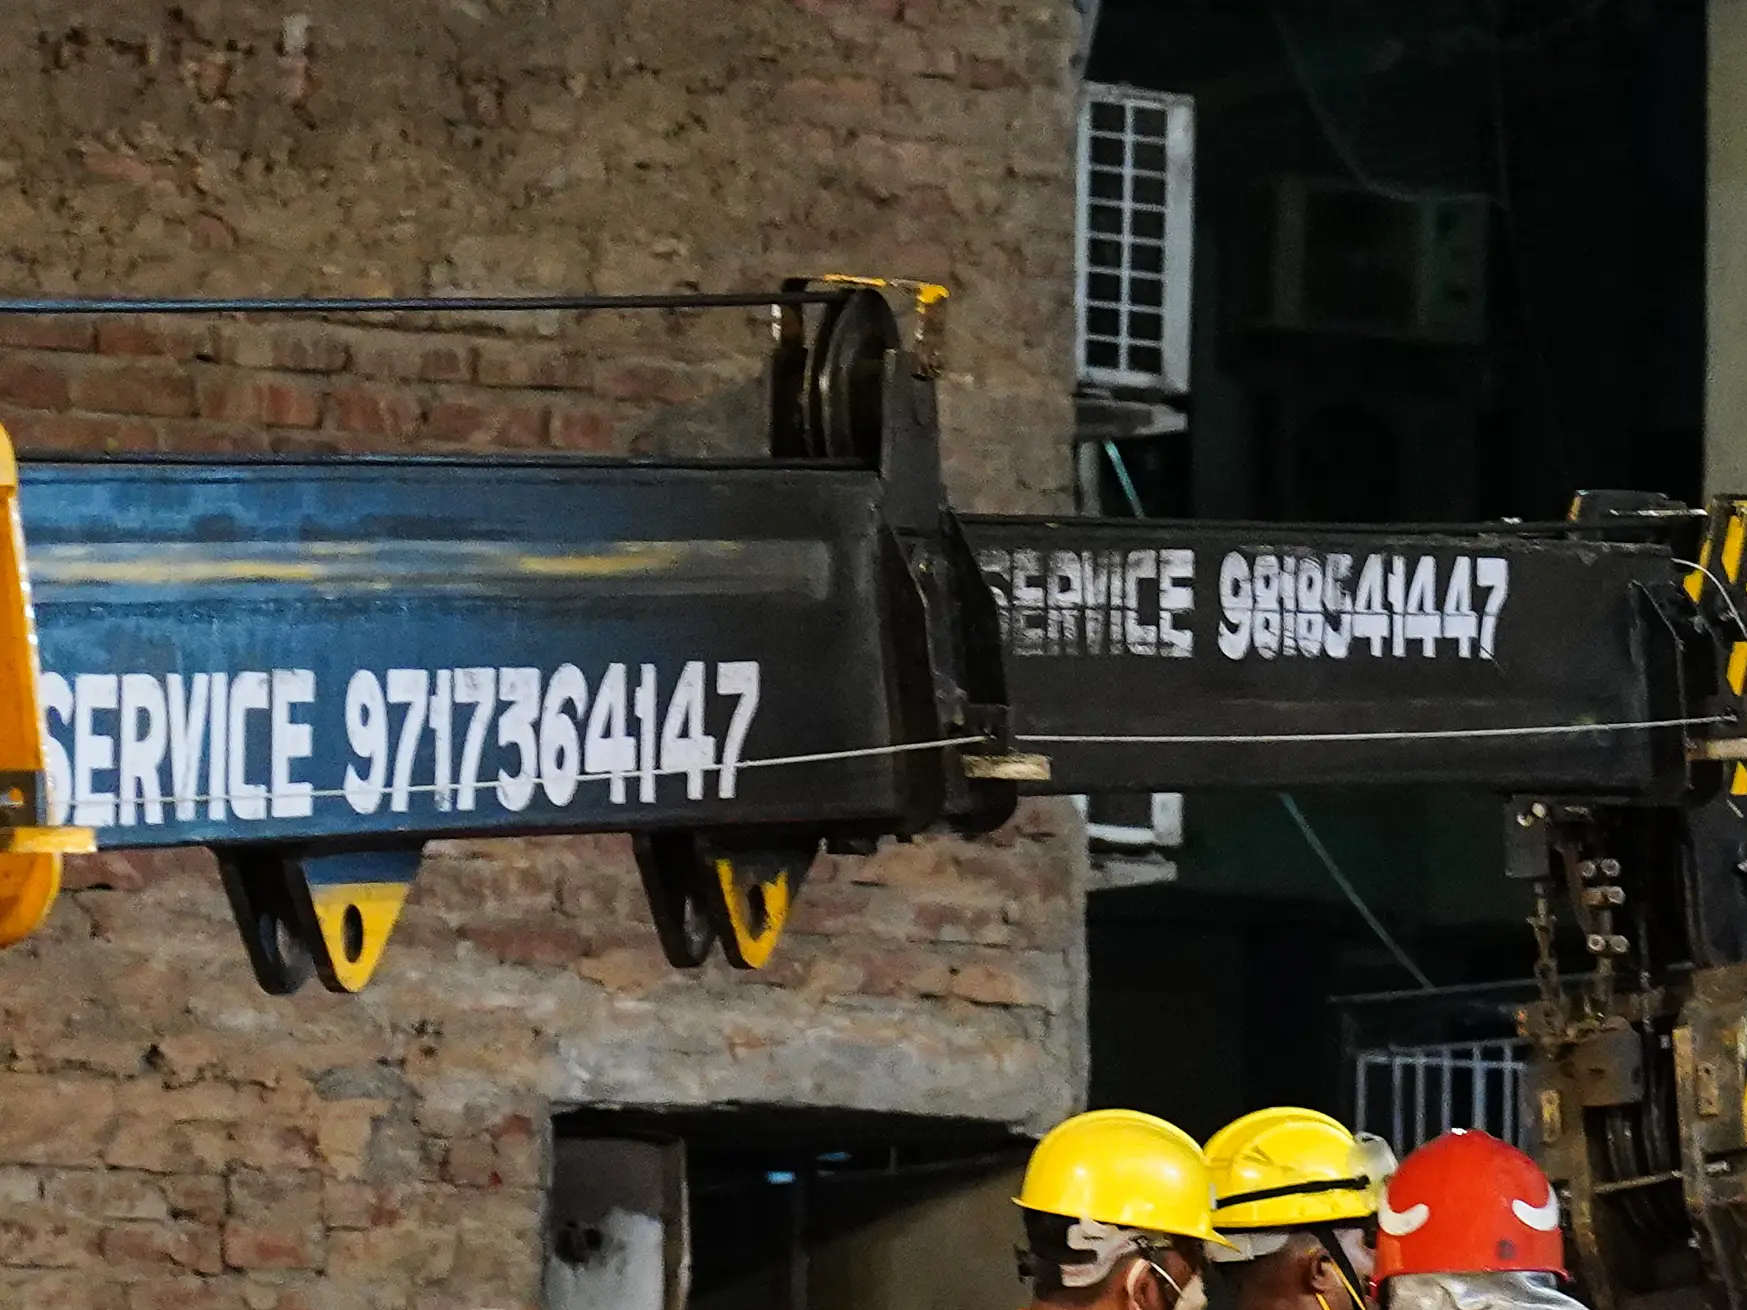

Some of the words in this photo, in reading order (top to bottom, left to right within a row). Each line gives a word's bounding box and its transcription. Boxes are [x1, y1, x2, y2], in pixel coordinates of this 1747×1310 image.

[978, 549, 1195, 657] SERVICE
[39, 669, 316, 827] SERVICE
[344, 661, 760, 815] 9717364147
